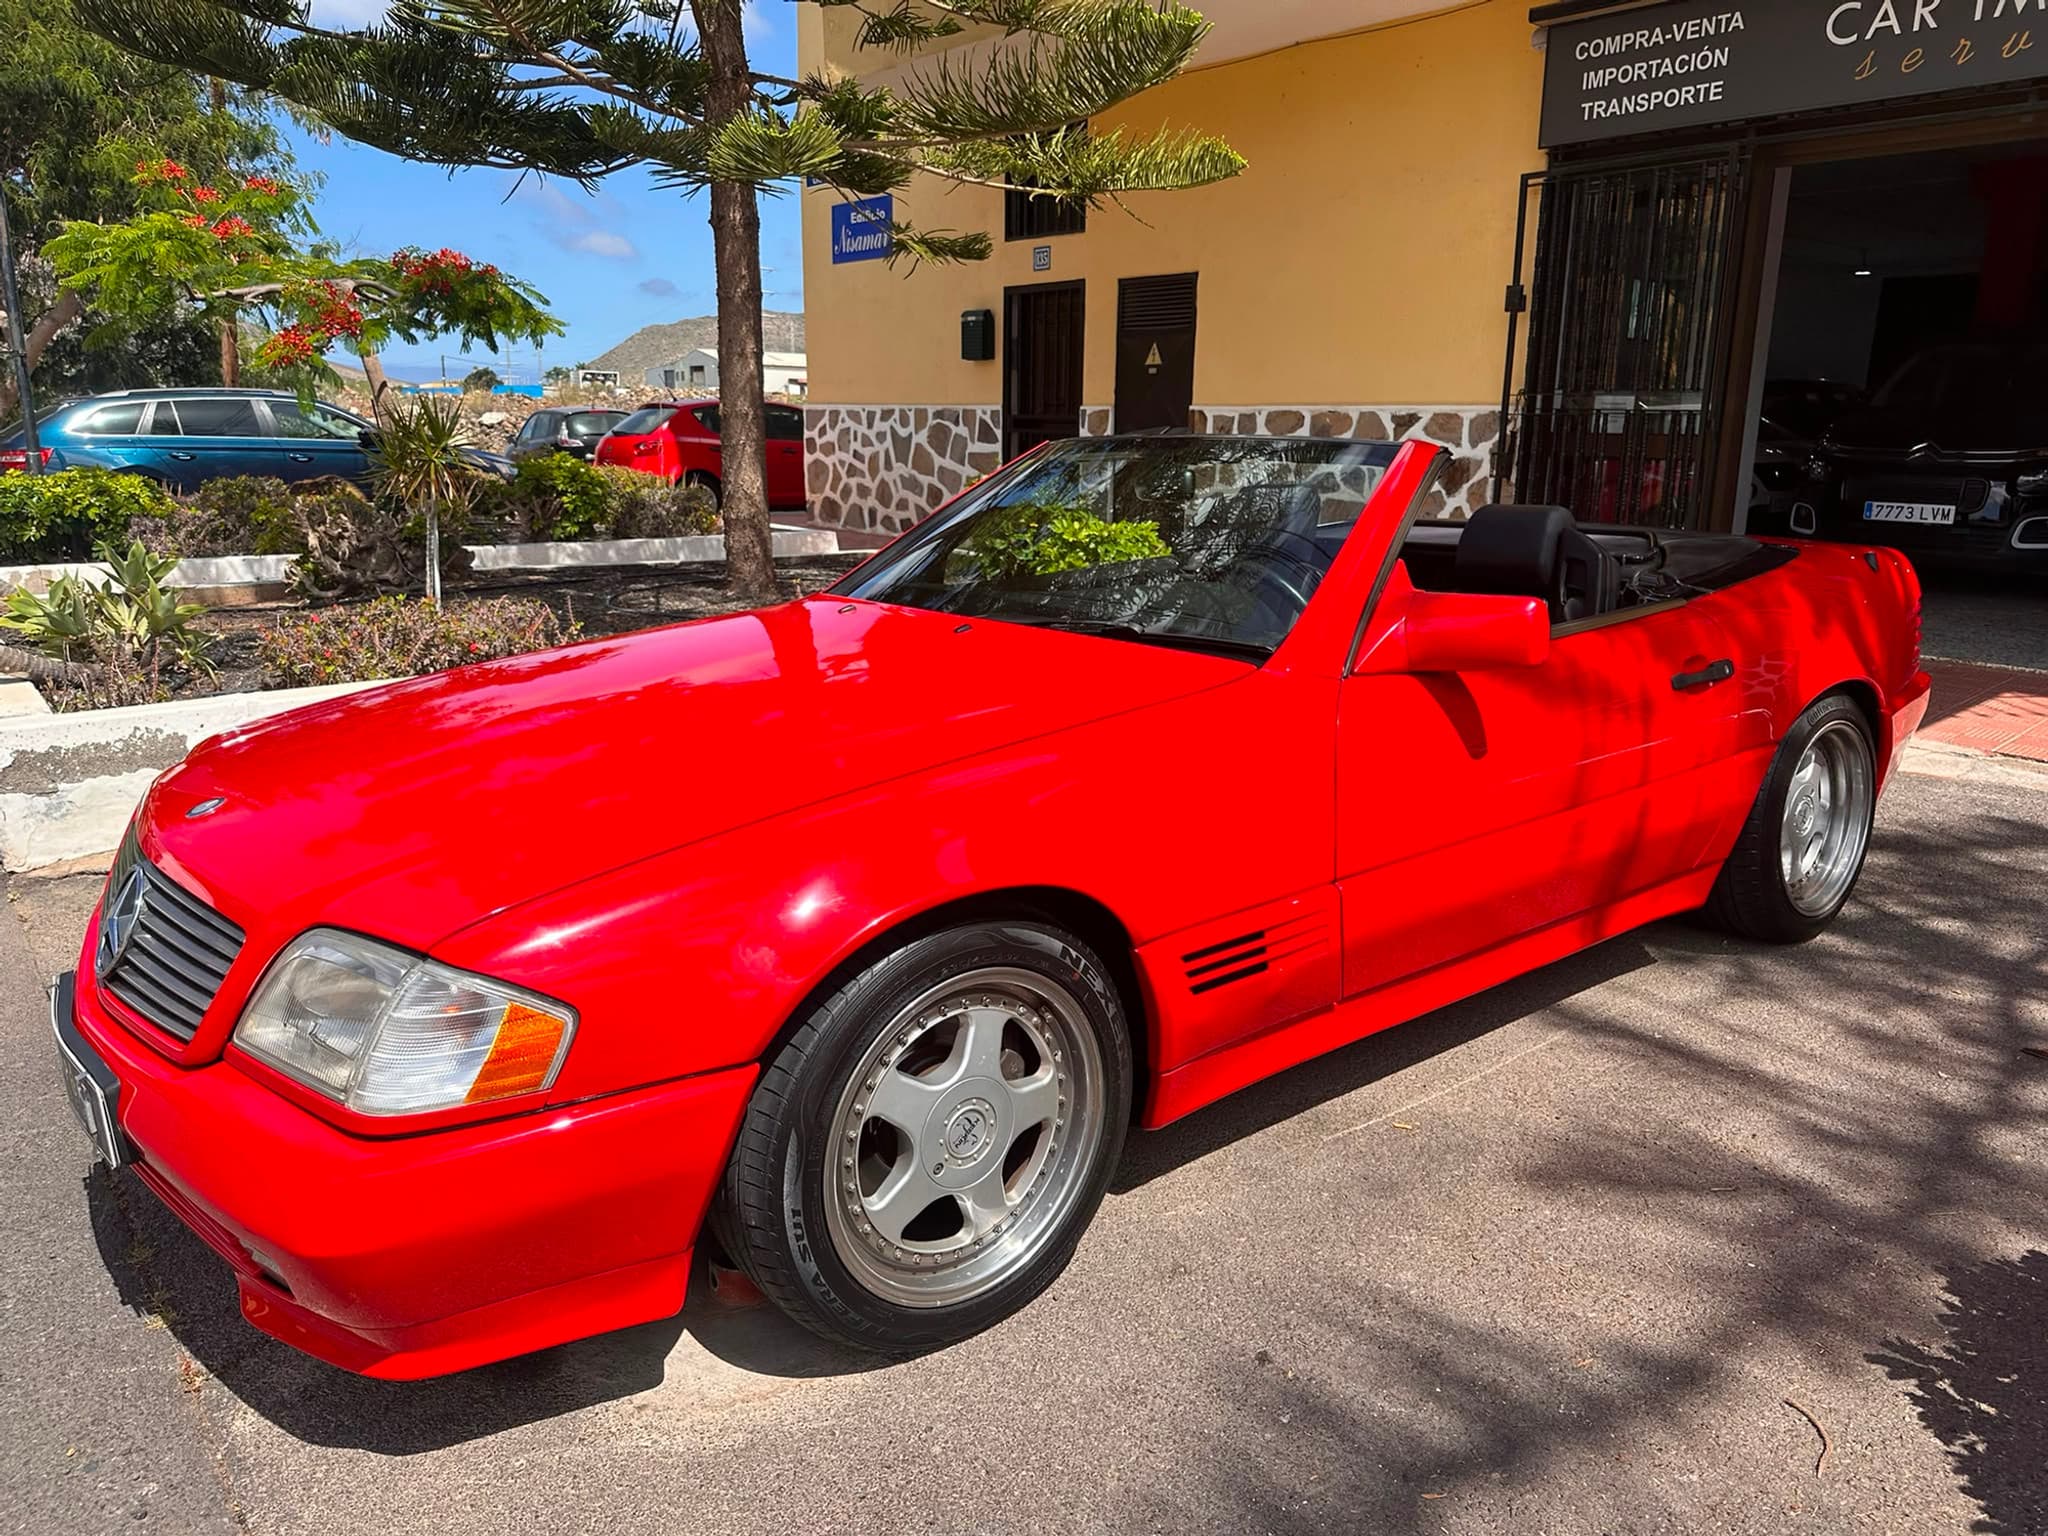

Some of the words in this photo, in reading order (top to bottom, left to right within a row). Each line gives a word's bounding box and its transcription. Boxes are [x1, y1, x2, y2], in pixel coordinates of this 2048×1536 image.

[1575, 11, 1745, 60] COMPRA-VENTA
[1825, 0, 1940, 46] CAR
[1582, 45, 1729, 91] IMPORTACIÓN
[1581, 80, 1724, 121] TRANSPORTE
[1875, 504, 1914, 520] 7773
[1919, 506, 1951, 521] LVM
